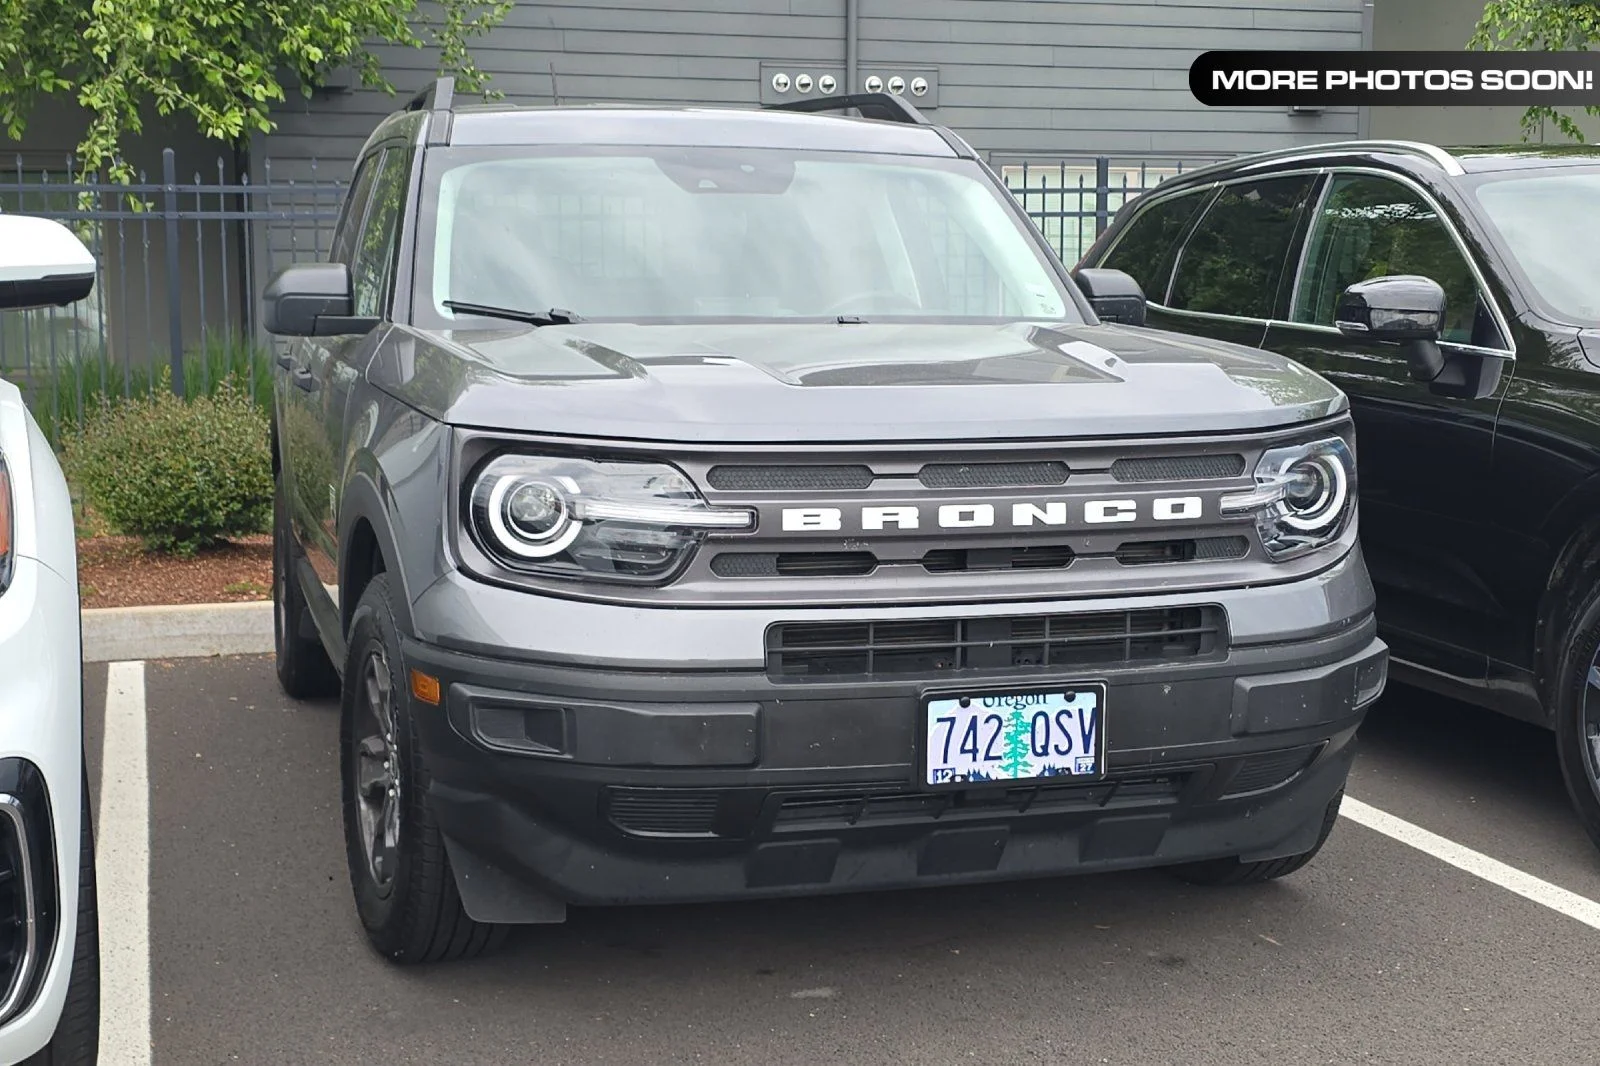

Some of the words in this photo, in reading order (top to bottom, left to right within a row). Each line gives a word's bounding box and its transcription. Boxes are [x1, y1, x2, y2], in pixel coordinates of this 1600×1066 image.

[781, 496, 1202, 531] BRONCO
[936, 714, 1003, 764] 742
[1030, 707, 1097, 757] QSV
[1080, 763, 1093, 772] 27
